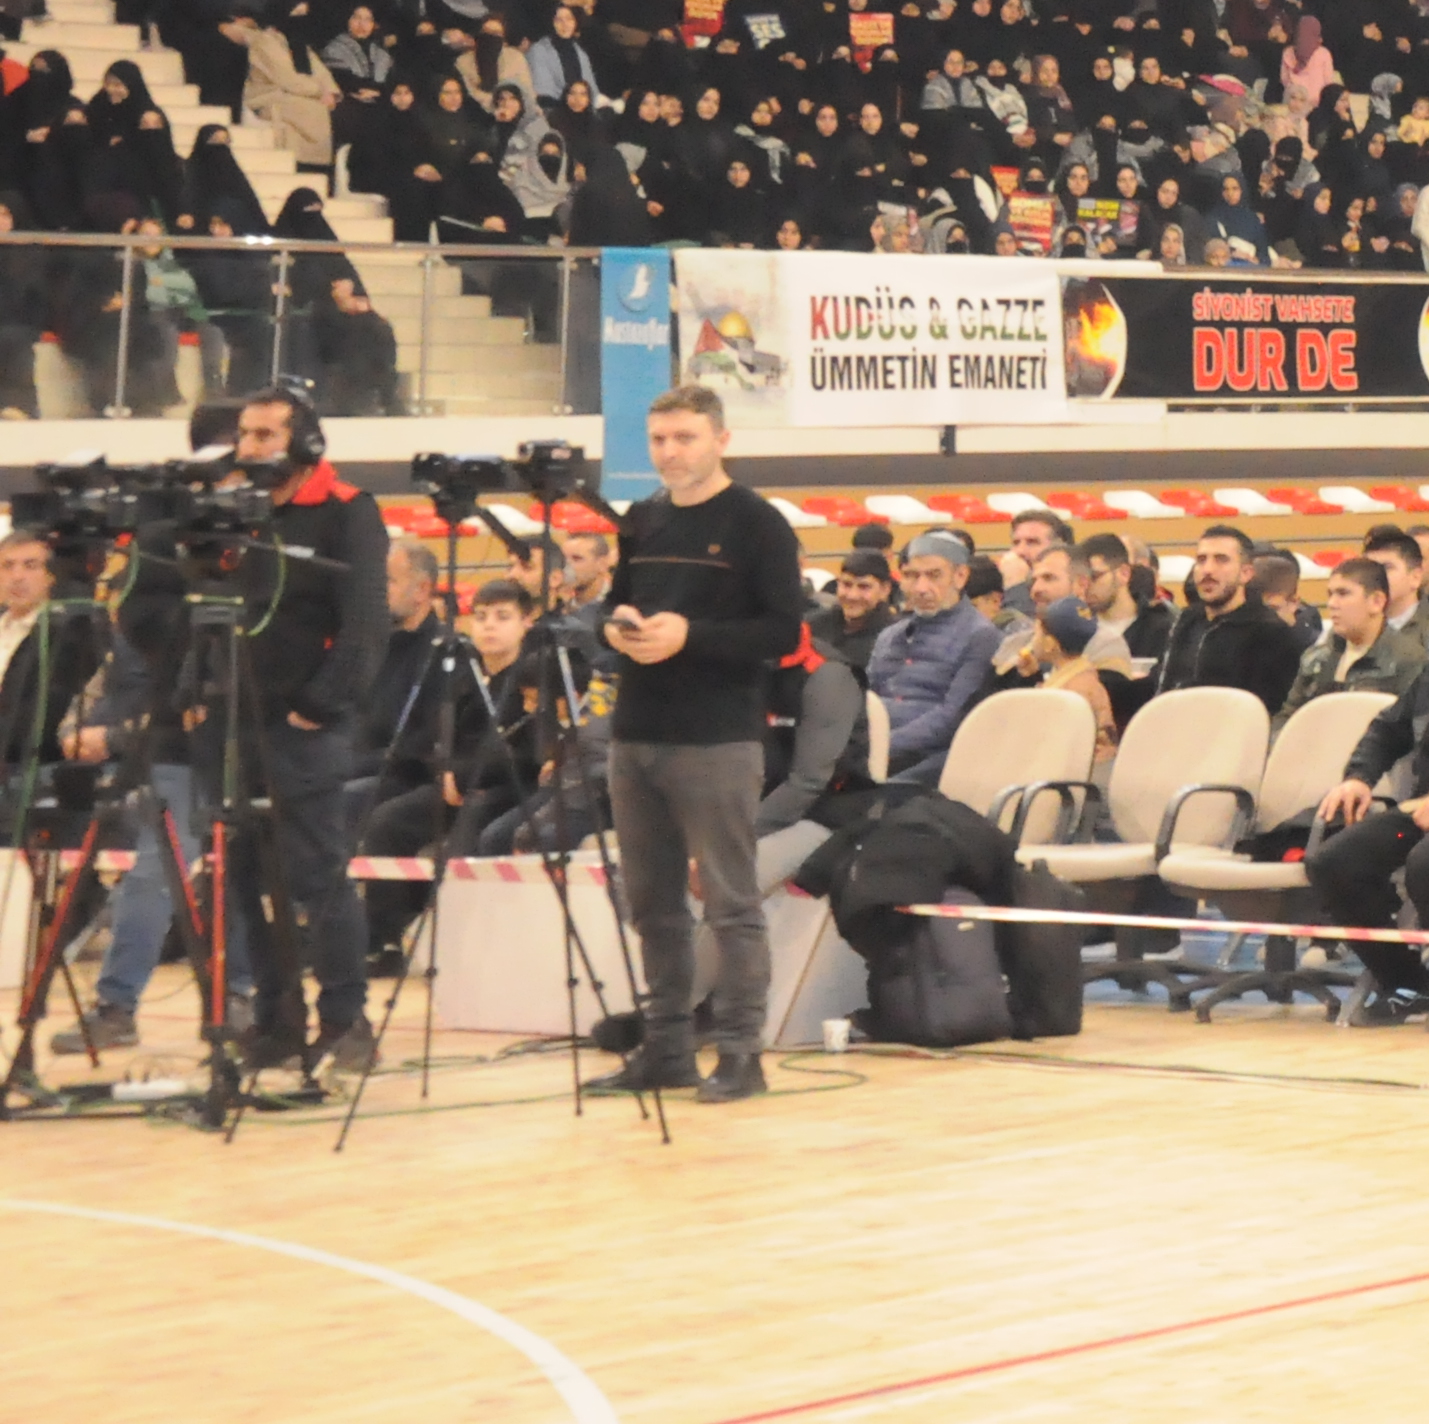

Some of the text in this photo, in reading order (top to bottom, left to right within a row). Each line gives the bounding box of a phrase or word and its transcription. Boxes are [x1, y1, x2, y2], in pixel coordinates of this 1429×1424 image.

[810, 285, 1048, 342] KUDÜS & GAZZE
[1192, 286, 1274, 322] SİYONİST
[810, 346, 1048, 391] ÜMMETİN EMANETİ
[1193, 327, 1359, 392] DUR DE
